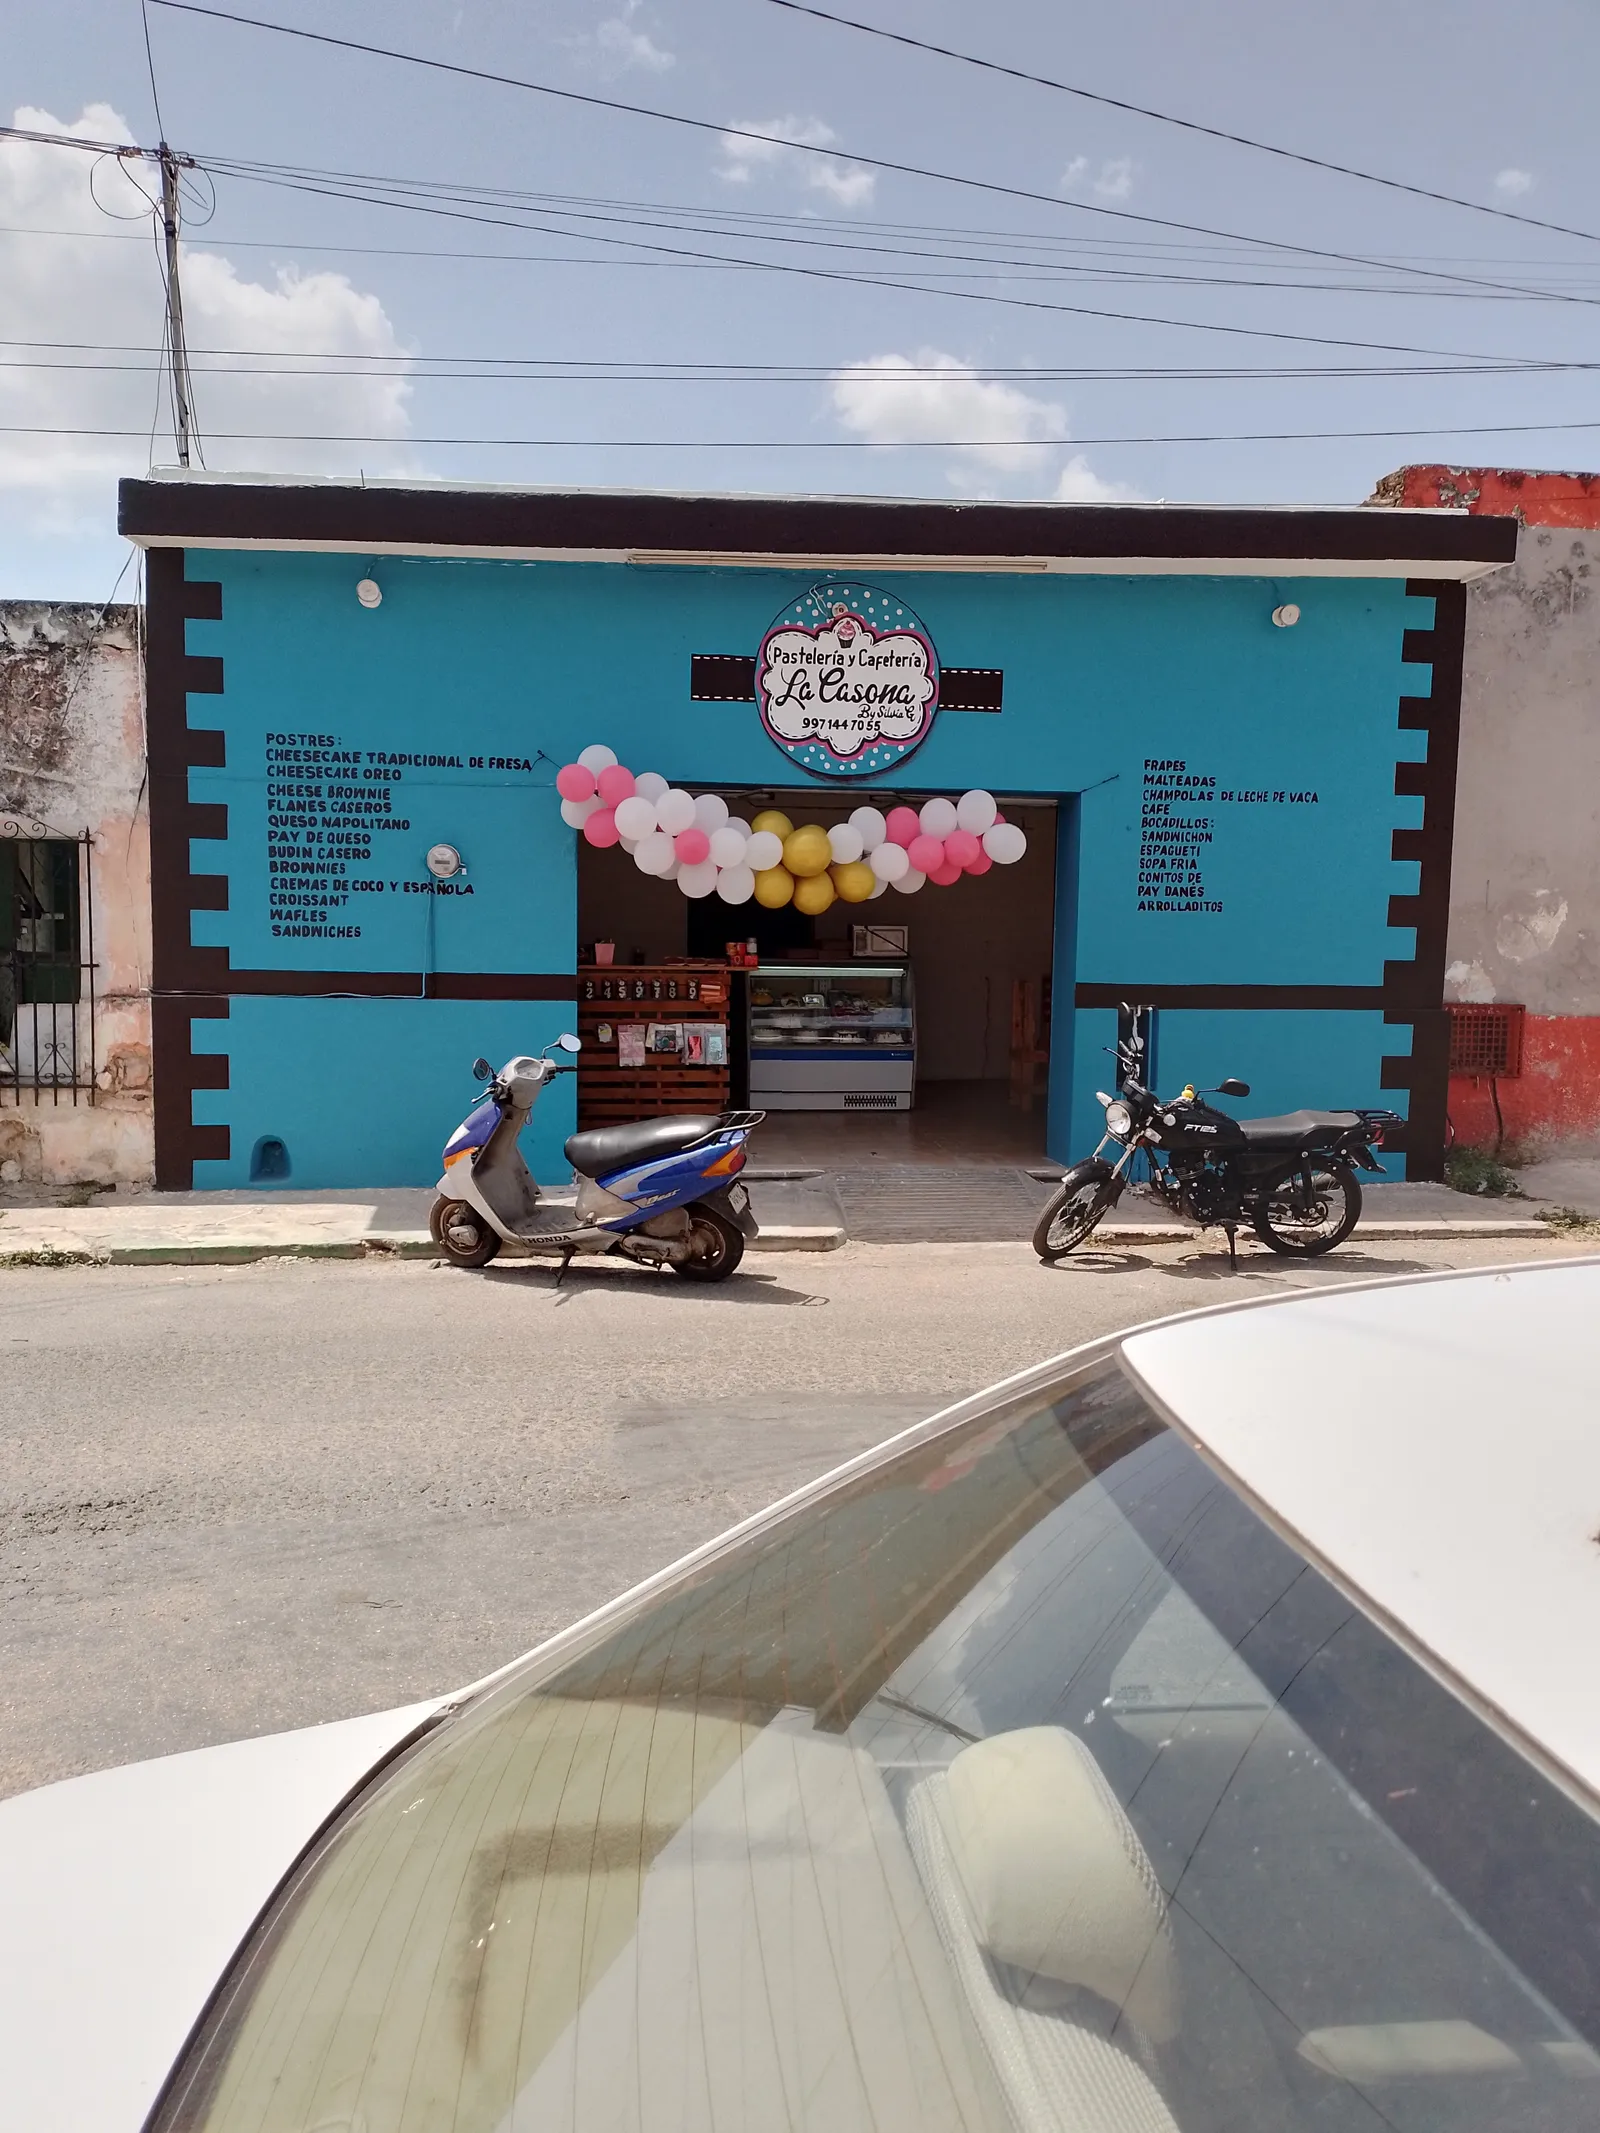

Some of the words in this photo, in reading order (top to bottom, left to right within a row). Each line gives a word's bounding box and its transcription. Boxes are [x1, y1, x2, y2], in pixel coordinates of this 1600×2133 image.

[774, 647, 844, 665] Pastelería
[848, 655, 855, 667] y
[859, 649, 921, 669] Cafetería
[775, 668, 815, 710] La
[819, 668, 916, 704] Casona
[858, 705, 875, 720] By
[876, 707, 904, 718] Silvia
[266, 733, 343, 747] POSTRES:
[266, 749, 361, 764] CHEESECAKE
[366, 752, 463, 768] TRADICIONAL
[469, 756, 483, 768] DE
[489, 757, 531, 771] FRESA
[1144, 759, 1186, 771] FRAPES
[267, 765, 358, 779] CHEESECAKE
[363, 768, 401, 781] OREO
[1143, 774, 1216, 787] MALTEADAS
[267, 784, 322, 798] CHEESE
[327, 786, 390, 800] BROWNIE
[1143, 789, 1214, 801] CHAMPOLAS
[1221, 792, 1234, 801] DE
[1238, 791, 1268, 802] LECHE
[1273, 792, 1284, 802] DE
[1289, 792, 1319, 803] VACA
[268, 799, 326, 812] FLANES
[331, 800, 391, 813] CASEROS
[268, 814, 317, 828] QUESO
[321, 816, 410, 830] NAPOLITANO
[1141, 817, 1214, 829] BOCADILLOS:
[268, 831, 301, 842] PAY
[306, 831, 323, 843] DE
[327, 832, 371, 845] QUESO
[1141, 831, 1212, 843] SANDWICHON
[268, 846, 312, 858] BUDIN
[318, 847, 371, 859] CASERO
[1140, 845, 1200, 856] ESPAGUETI
[269, 861, 346, 874] BROWNIES
[1140, 858, 1167, 869] SOPA
[1171, 859, 1197, 869] FRIA
[1138, 872, 1183, 883] CONITOS
[1188, 872, 1201, 883] DE
[270, 877, 328, 891] CREMAS
[333, 879, 349, 891] DE
[352, 880, 383, 892] COCO
[390, 882, 398, 892] Y
[404, 880, 474, 895] ESPAÑOLA
[1138, 886, 1160, 897] PAY
[1165, 883, 1204, 897] DANÉS
[270, 893, 349, 906] CROISSANT
[1137, 901, 1223, 912] ARROLLADITOS
[270, 909, 327, 922] WAFLES
[272, 924, 361, 938] SANDWICHES
[527, 1235, 571, 1243] HONDA
